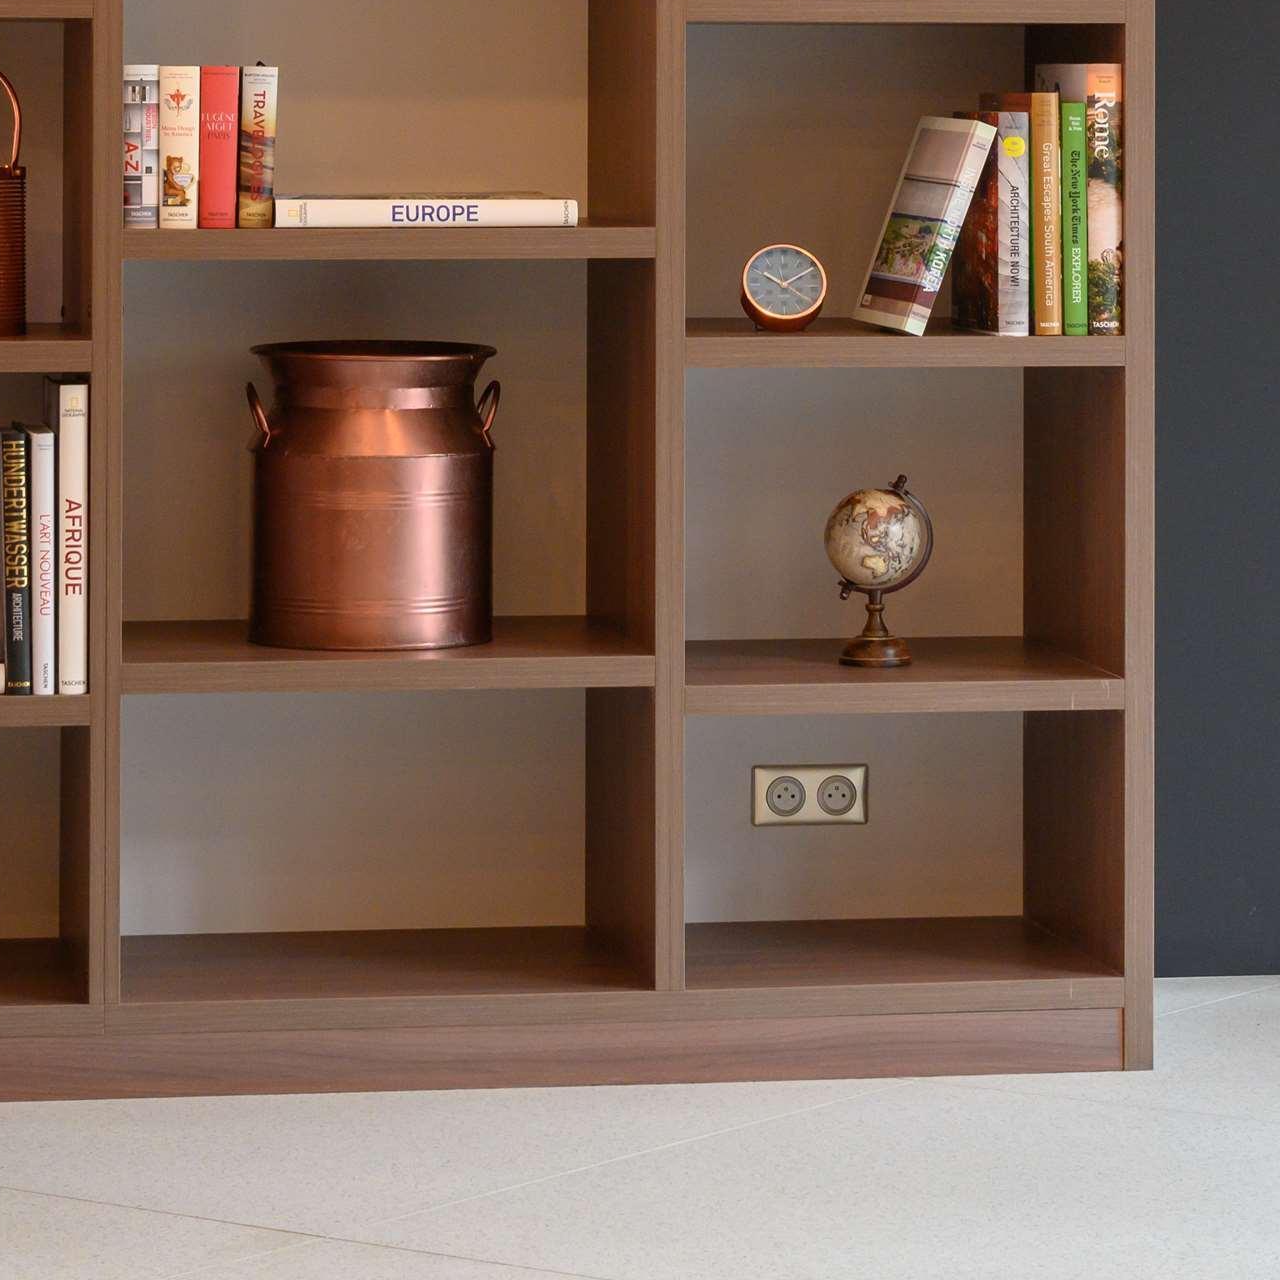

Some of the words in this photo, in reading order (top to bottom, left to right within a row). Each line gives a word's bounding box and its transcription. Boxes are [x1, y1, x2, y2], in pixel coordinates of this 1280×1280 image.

[251, 90, 266, 201] TRAVELOGUES
[1094, 91, 1116, 160] Rome
[124, 141, 139, 172] A-Z
[1042, 142, 1052, 171] Great
[1071, 150, 1080, 168] The
[1041, 176, 1053, 222] Escapes
[1071, 169, 1080, 189] New
[391, 204, 479, 222] EUROPE
[1010, 185, 1020, 258] ARCHITECTURE
[1069, 190, 1080, 216] York
[1044, 224, 1055, 257] South
[1071, 216, 1081, 245] Times
[923, 251, 946, 292] KOREA
[1010, 261, 1020, 287] NOW!
[1044, 261, 1055, 306] America
[1071, 247, 1081, 304] EXPLORER
[2, 440, 28, 588] HUNDERTWASSER
[39, 514, 51, 545] L'ART
[65, 498, 83, 596] AFRIQUE
[39, 550, 51, 616] NOUVEAU
[12, 593, 23, 642] ARCHITECTURE
